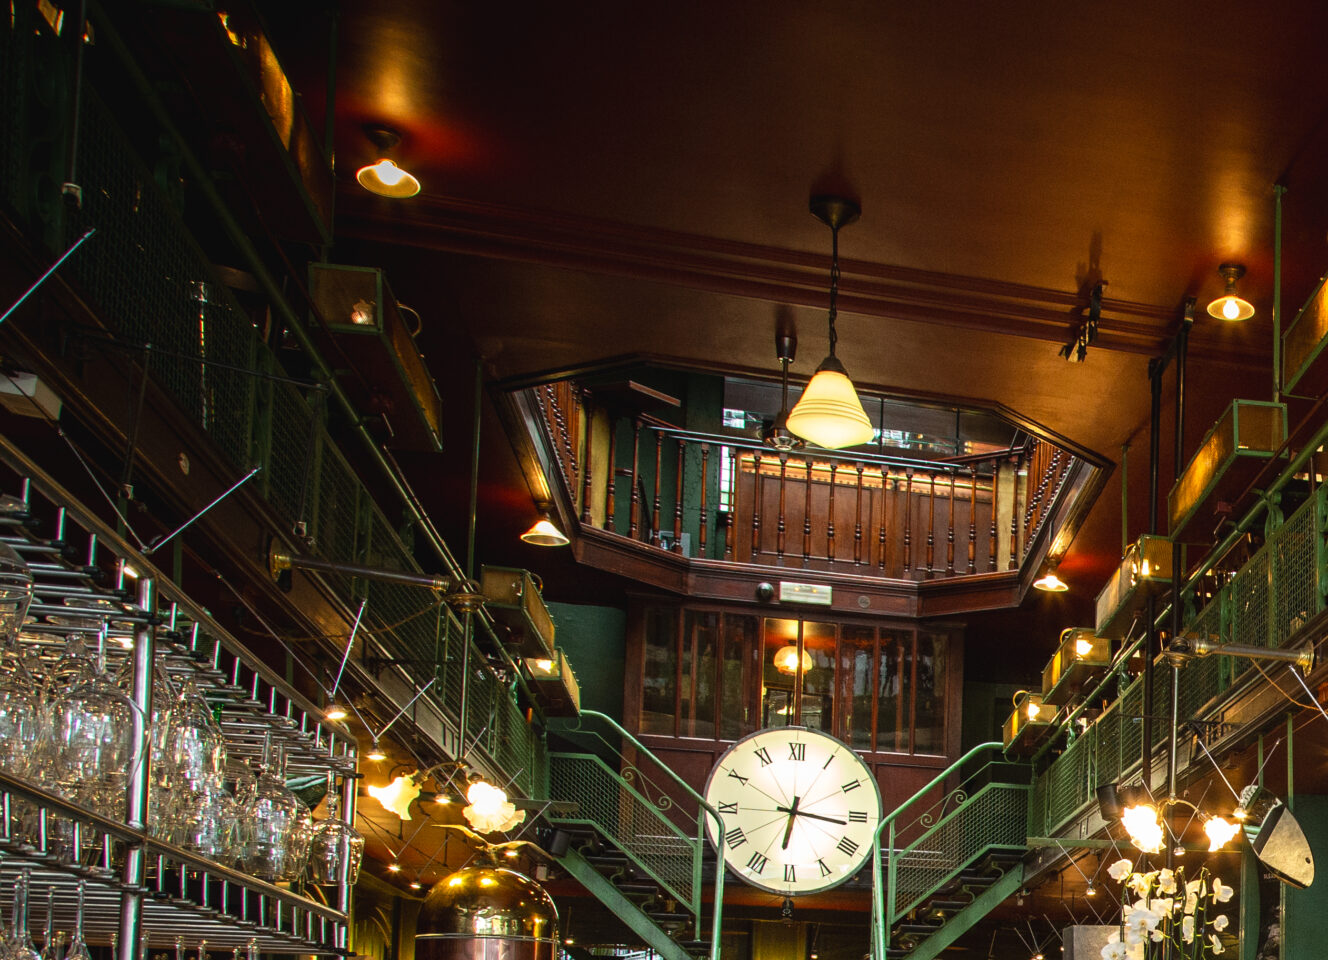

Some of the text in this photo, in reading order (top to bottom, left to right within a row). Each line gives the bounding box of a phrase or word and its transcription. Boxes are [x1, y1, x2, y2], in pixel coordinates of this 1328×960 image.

[754, 747, 773, 768] XI
[788, 742, 807, 761] XII
[822, 754, 836, 770] I
[728, 768, 749, 786] X
[841, 779, 862, 793] II
[718, 800, 738, 815] IX
[848, 810, 868, 823] III
[725, 827, 749, 851] VIII
[836, 836, 860, 857] IIII
[746, 851, 771, 875] VII
[816, 857, 832, 877] V
[783, 863, 798, 883] VI
